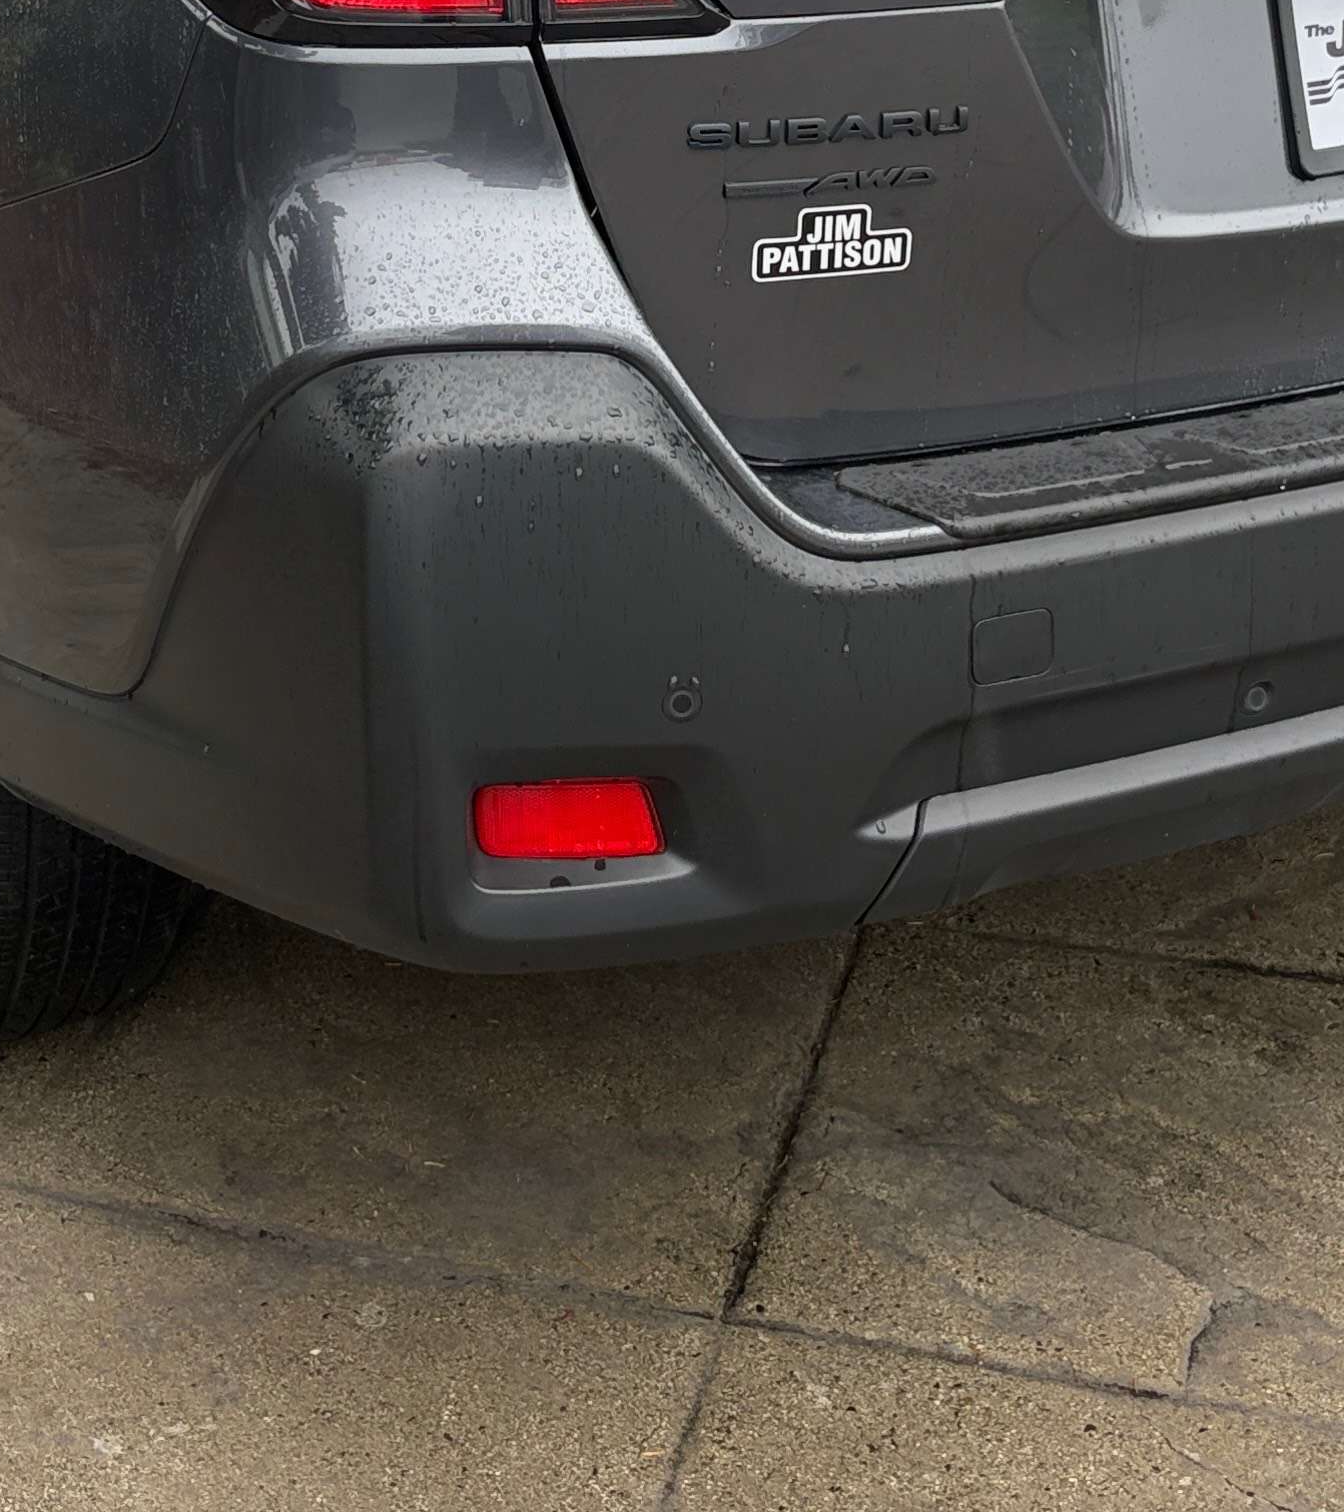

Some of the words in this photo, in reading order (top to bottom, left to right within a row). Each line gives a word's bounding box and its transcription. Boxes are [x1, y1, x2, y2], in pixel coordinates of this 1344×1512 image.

[1304, 22, 1335, 40] The
[688, 106, 968, 149] SUBARU
[804, 167, 937, 195] AWD
[806, 213, 861, 244] JIM
[762, 238, 902, 275] PATTISON
